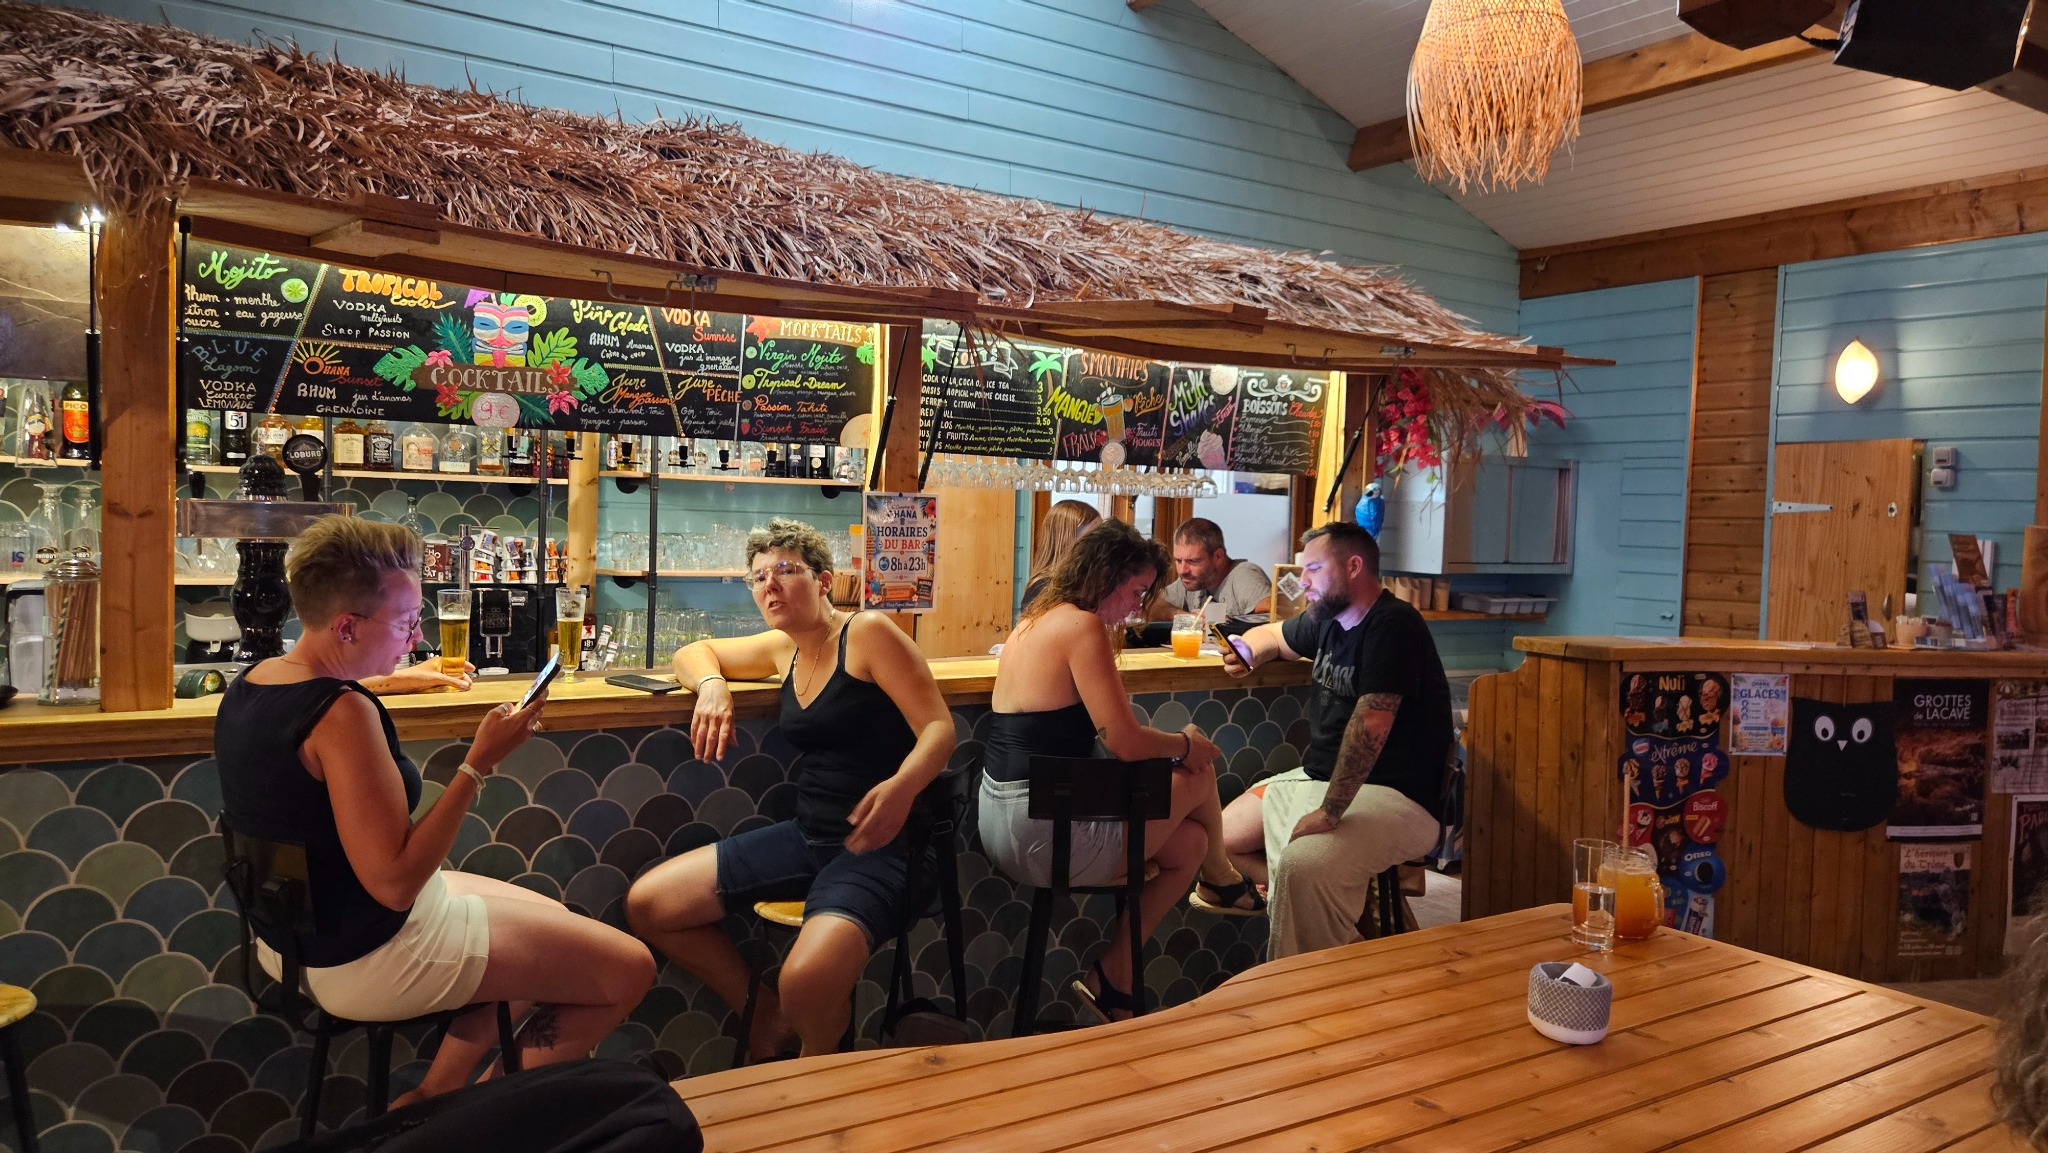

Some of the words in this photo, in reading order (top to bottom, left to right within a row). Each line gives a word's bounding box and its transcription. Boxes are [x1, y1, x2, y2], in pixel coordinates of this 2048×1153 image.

[199, 250, 288, 290] Mojito
[338, 268, 443, 301] TROPICAL
[233, 292, 280, 307] menthe
[332, 299, 387, 314] VODKA
[390, 292, 457, 310] Cooler
[184, 302, 219, 318] itron
[235, 309, 256, 319] eau
[260, 310, 303, 327] gazeuse
[608, 310, 649, 337] Colada
[779, 318, 863, 345] MOCKTAILS
[588, 331, 620, 348] RHUM
[665, 342, 706, 354] VODKA
[758, 339, 798, 372] Virgin
[801, 342, 847, 371] Mojito
[203, 356, 261, 379] Lagoon
[1080, 352, 1149, 382] SMOOTHIES
[199, 379, 257, 393] VODKA
[430, 367, 560, 394] COCKTAILS
[753, 367, 802, 395] Tropical
[802, 376, 847, 391] Dream
[922, 373, 939, 383] COCA
[958, 377, 974, 387] COCA
[986, 381, 997, 389] ICE
[998, 381, 1010, 391] TEA
[1036, 381, 1044, 394] 3
[205, 390, 256, 403] Curaçao
[297, 382, 337, 400] RHUM
[351, 392, 368, 408] jus
[705, 383, 744, 404] PÊCHE
[921, 385, 941, 396] OASIS
[1037, 394, 1043, 405] 3
[65, 402, 89, 410] PICO
[198, 397, 256, 410] LEMONADE
[479, 400, 494, 421] 9
[753, 394, 793, 412] Passion
[796, 401, 829, 413] Tahiti
[953, 400, 976, 409] CITRON
[1036, 406, 1052, 418] 3,50
[230, 414, 244, 428] 51
[920, 407, 935, 417] RED
[1036, 416, 1051, 427] 3,50
[751, 420, 793, 436] Sunset
[799, 421, 829, 435] Fraise
[919, 418, 953, 430] DIALOS
[1048, 427, 1054, 436] 3
[946, 431, 969, 441] FRUITS
[1133, 437, 1161, 448] ROUGES
[290, 450, 321, 459] LOBURG
[877, 526, 928, 538] HORAIRES
[884, 541, 899, 550] DU
[901, 540, 921, 550] BAR
[890, 556, 903, 571] 8h
[908, 556, 926, 571] 23h
[1739, 688, 1780, 700] GLACES
[1913, 693, 1972, 709] GROTTES
[1913, 712, 1923, 720] de
[1926, 707, 1970, 720] LACAVE
[1684, 850, 1712, 862] OREO
